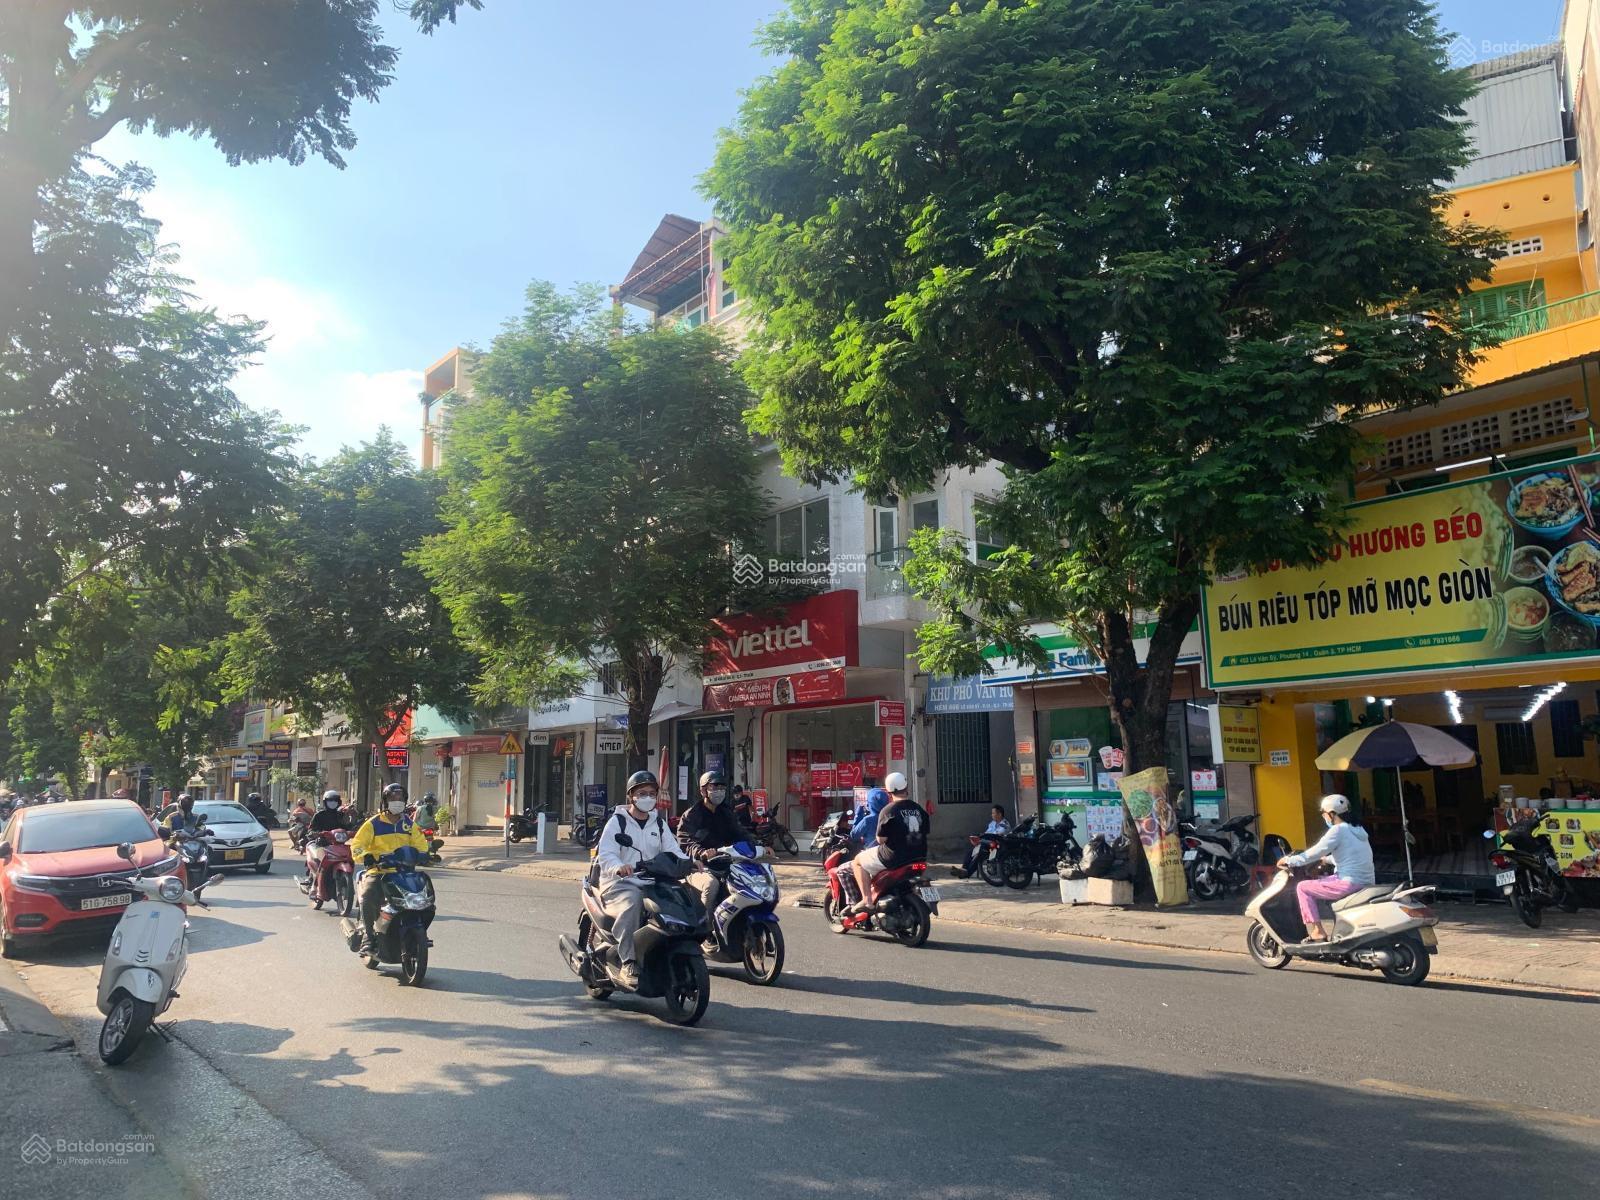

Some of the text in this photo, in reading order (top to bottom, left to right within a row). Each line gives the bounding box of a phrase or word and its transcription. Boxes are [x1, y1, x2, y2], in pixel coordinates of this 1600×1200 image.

[1349, 522, 1426, 558] HƯƠNG
[1434, 506, 1483, 544] BÉO
[1218, 558, 1492, 632] BÚN RIÊU TÓP MỠ MỌC GIÒN
[728, 619, 812, 658] viettel
[930, 686, 950, 702] KHU
[954, 679, 972, 700] PHỐ
